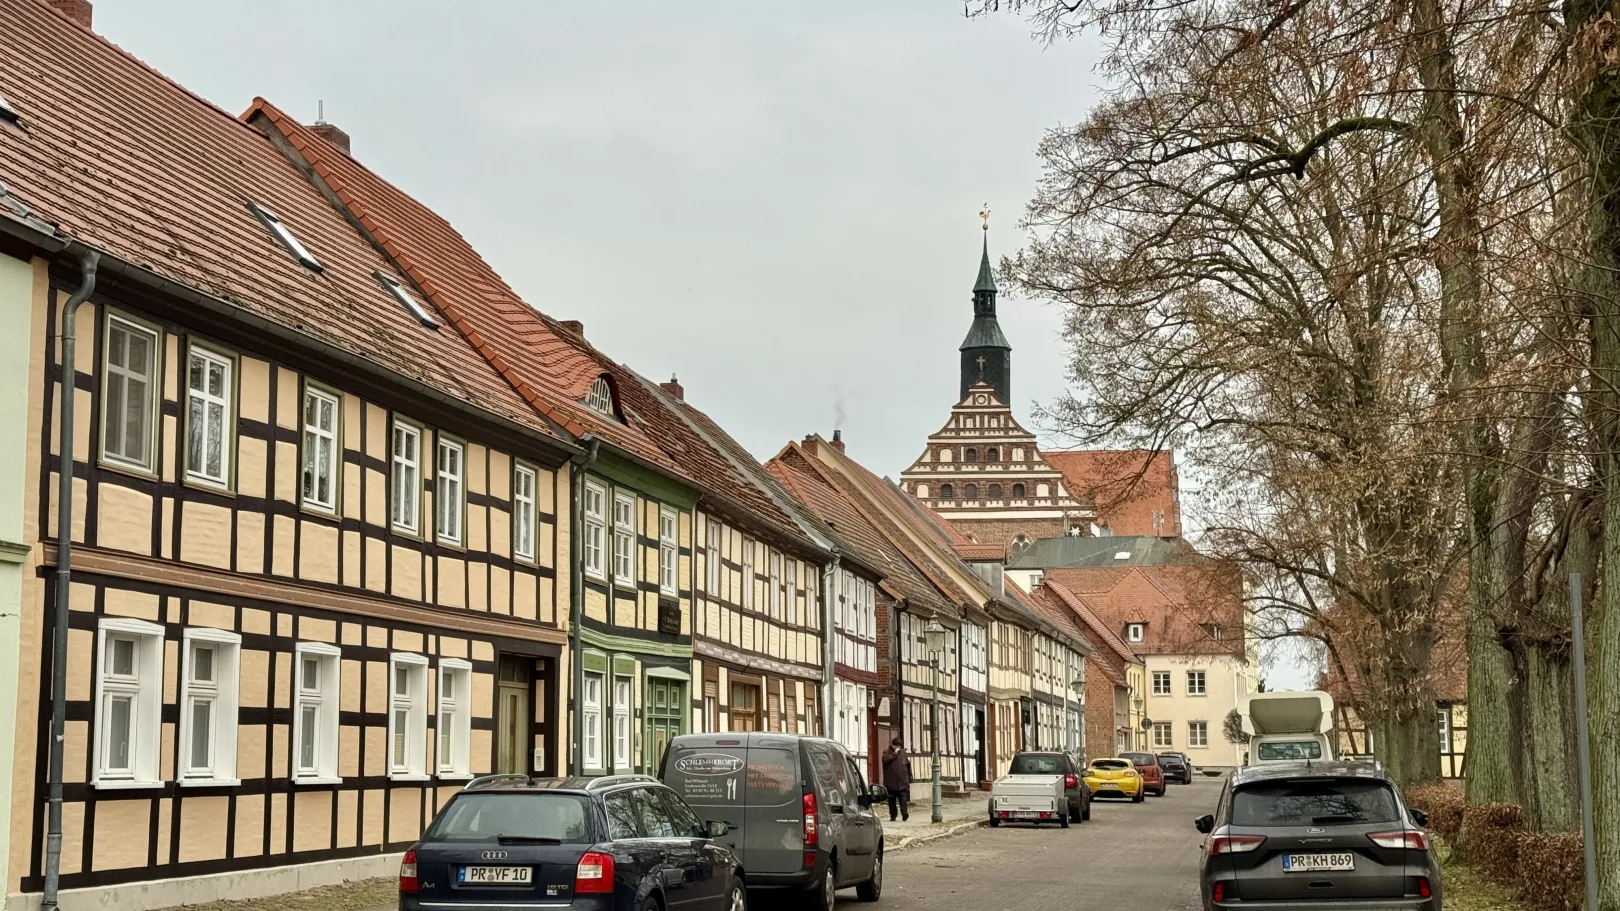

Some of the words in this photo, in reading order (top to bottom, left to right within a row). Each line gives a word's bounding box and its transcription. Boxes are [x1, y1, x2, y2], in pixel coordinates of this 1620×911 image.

[680, 759, 739, 770] SCHLEMMERORT
[1290, 855, 1305, 867] PR
[1312, 855, 1328, 867] KH
[1330, 854, 1352, 866] 869
[471, 867, 486, 880] PR
[494, 867, 511, 880] YF
[512, 868, 527, 880] 10
